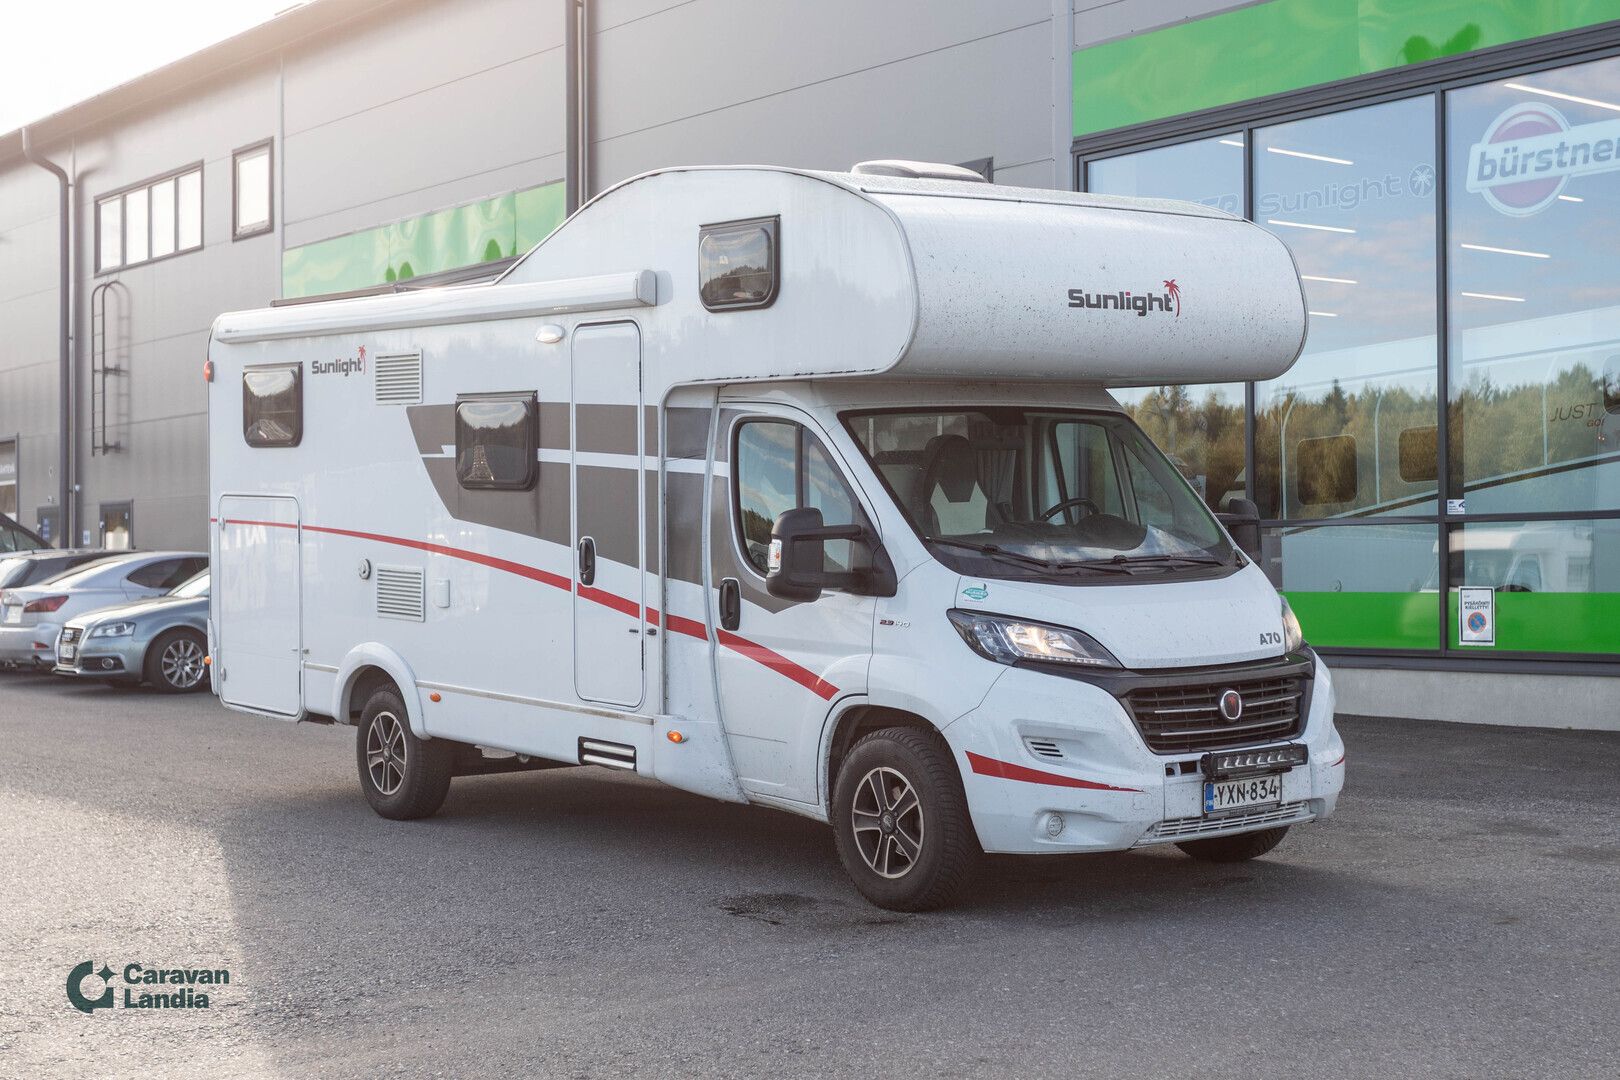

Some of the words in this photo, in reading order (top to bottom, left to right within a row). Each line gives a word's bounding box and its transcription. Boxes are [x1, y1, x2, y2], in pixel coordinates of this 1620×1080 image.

[1068, 288, 1173, 317] Sunlight
[311, 357, 362, 377] Sunlight
[1550, 402, 1598, 422] JUST
[1260, 632, 1281, 645] A70
[1215, 778, 1278, 806] YXN-834
